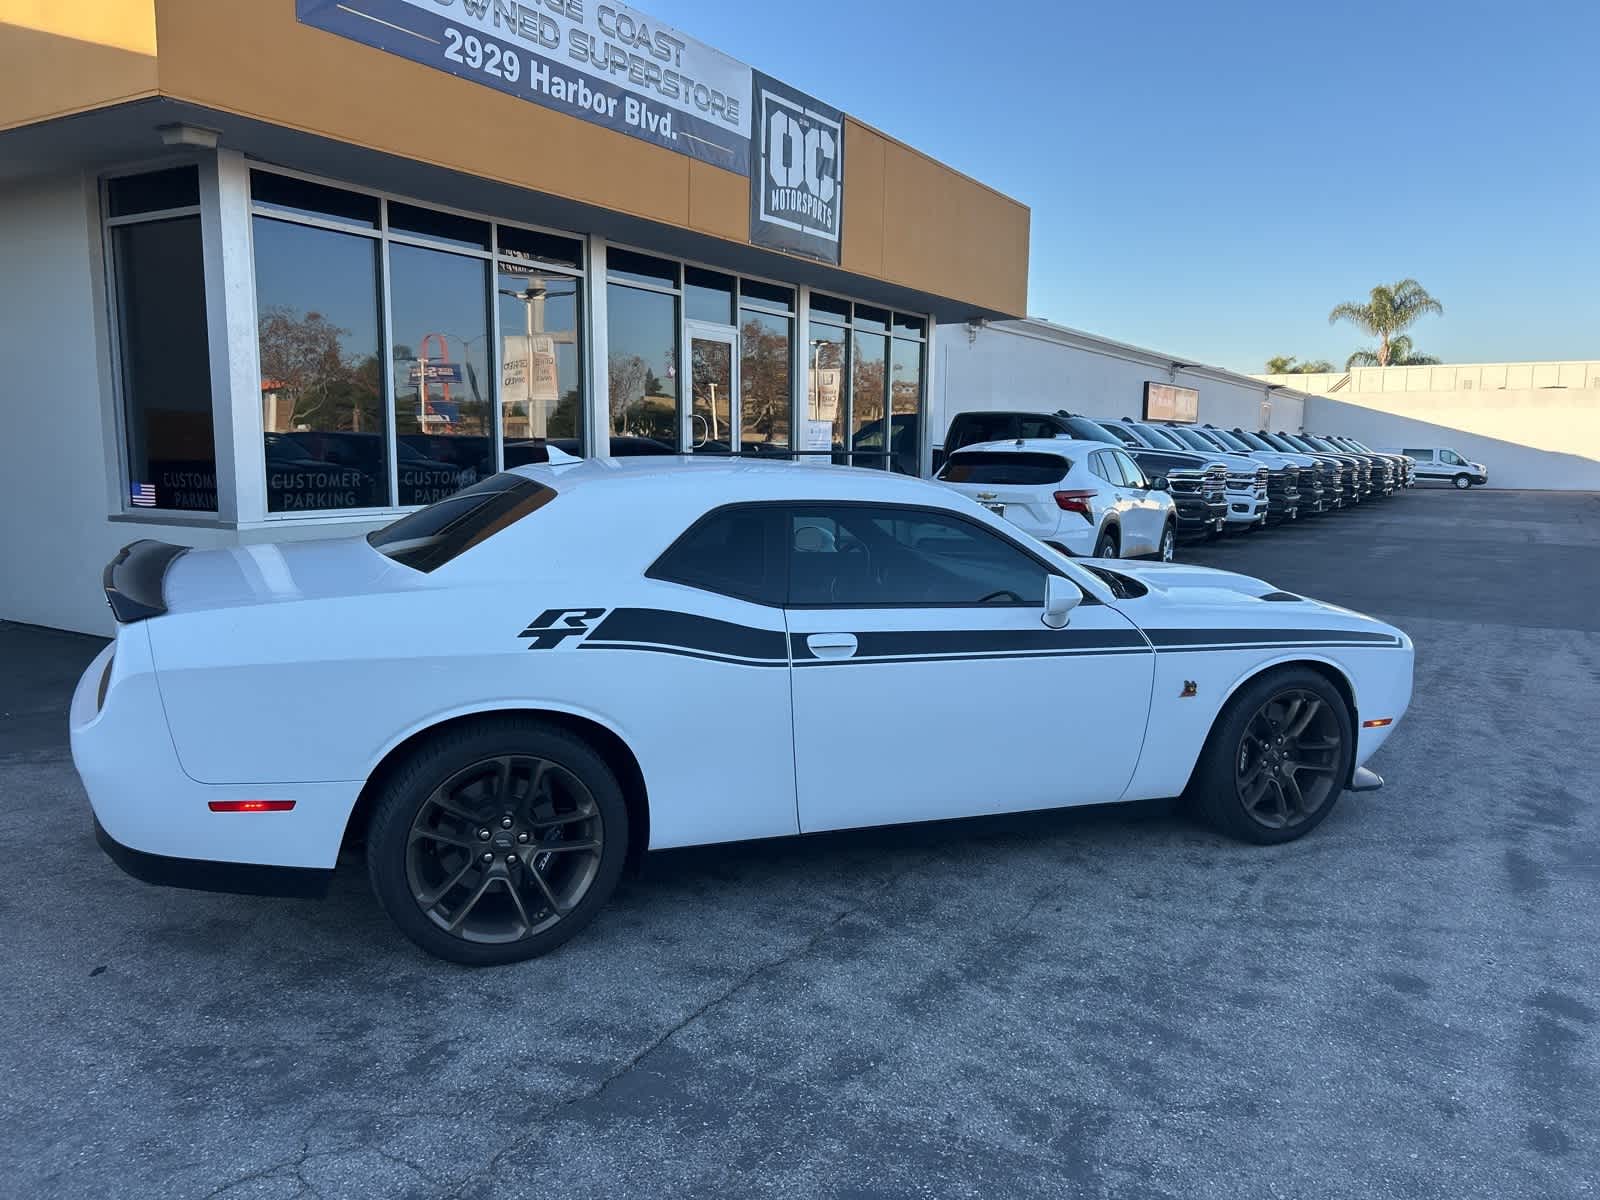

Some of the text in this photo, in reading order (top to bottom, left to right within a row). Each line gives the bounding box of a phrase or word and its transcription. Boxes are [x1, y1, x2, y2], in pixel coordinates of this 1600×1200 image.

[433, 0, 740, 126] WNED SUPERSTORE
[598, 4, 686, 68] COAST
[444, 27, 678, 140] 2929 Harbor Blvd.
[769, 109, 835, 203] OC
[771, 188, 832, 229] MOTORSPORTS
[271, 472, 361, 490] CUSTOMER
[283, 491, 357, 509] PARKING
